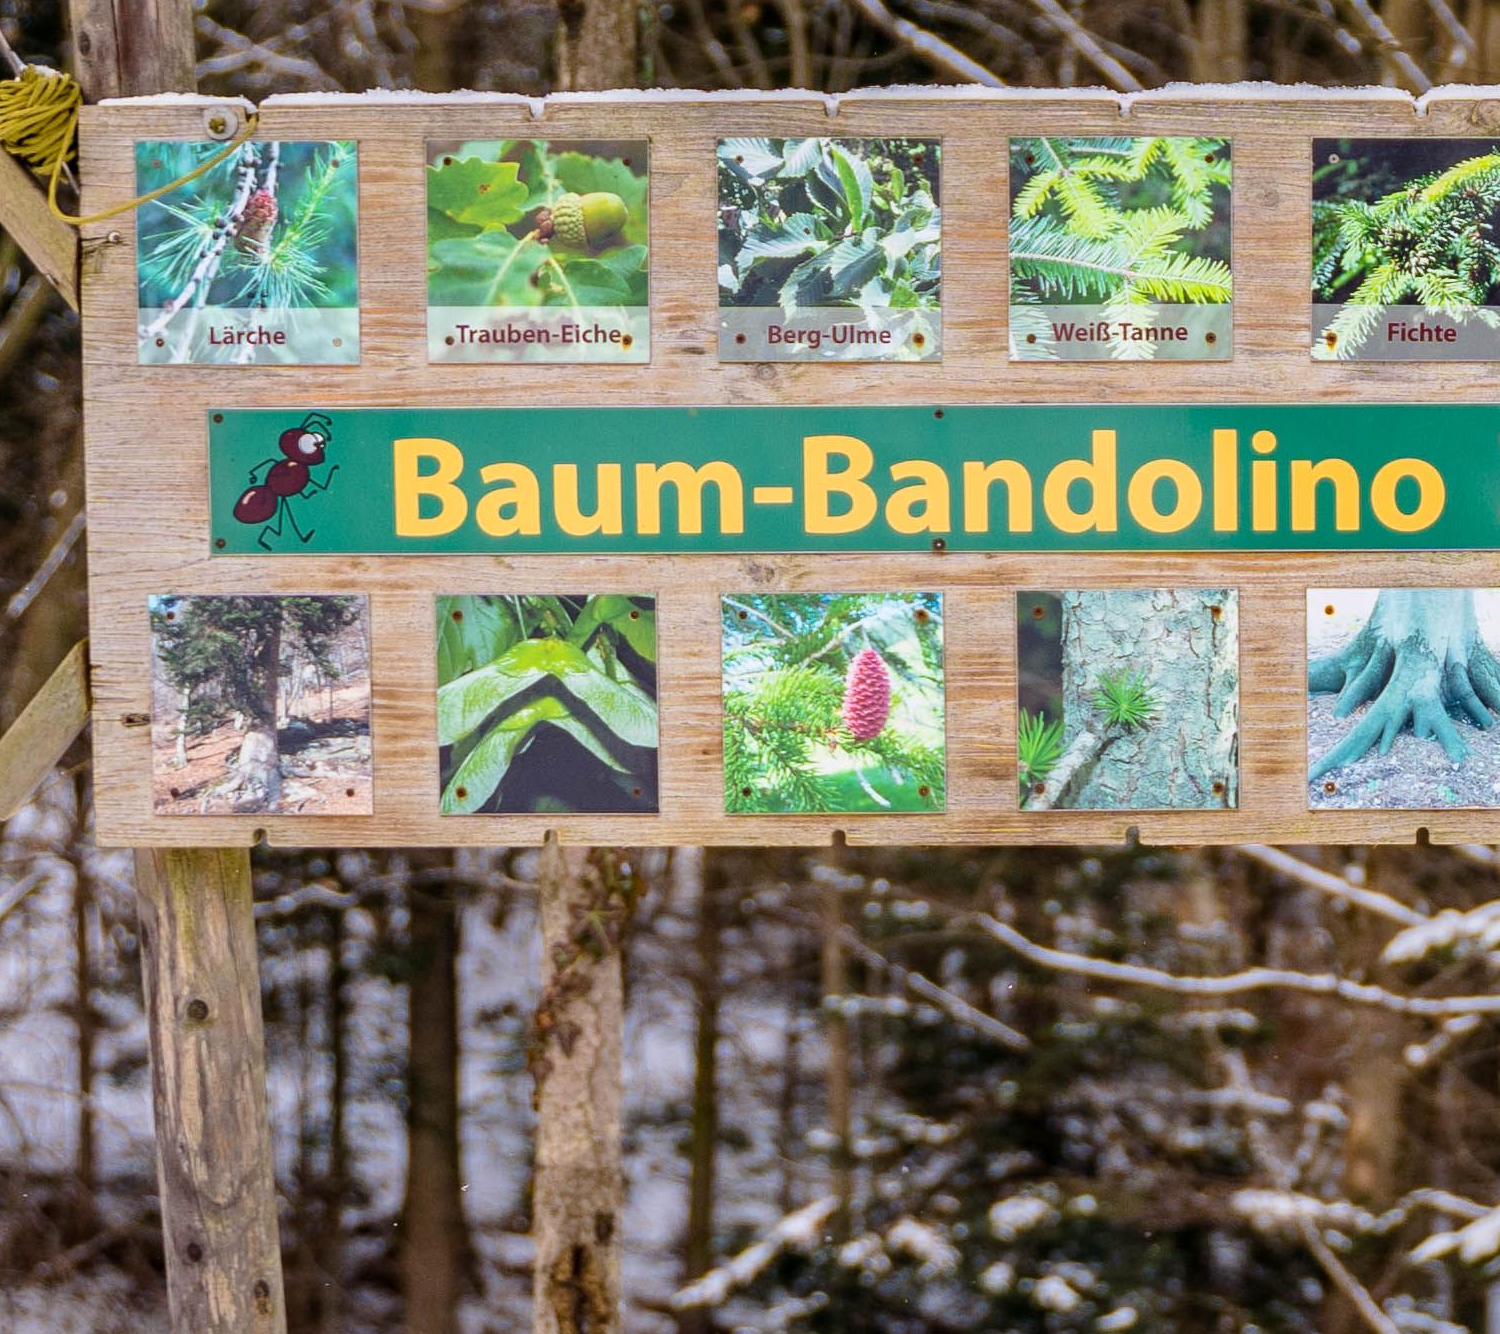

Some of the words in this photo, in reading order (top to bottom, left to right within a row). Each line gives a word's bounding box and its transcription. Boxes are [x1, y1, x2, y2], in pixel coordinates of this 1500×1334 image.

[209, 323, 286, 346] Lärche
[456, 323, 621, 345] Trauben-Eiche
[767, 324, 892, 349] Berg-Ulme
[1052, 322, 1189, 343] Weiß-Tanne
[1387, 322, 1457, 343] Fichte
[392, 428, 1446, 537] Baum-Bandolino
